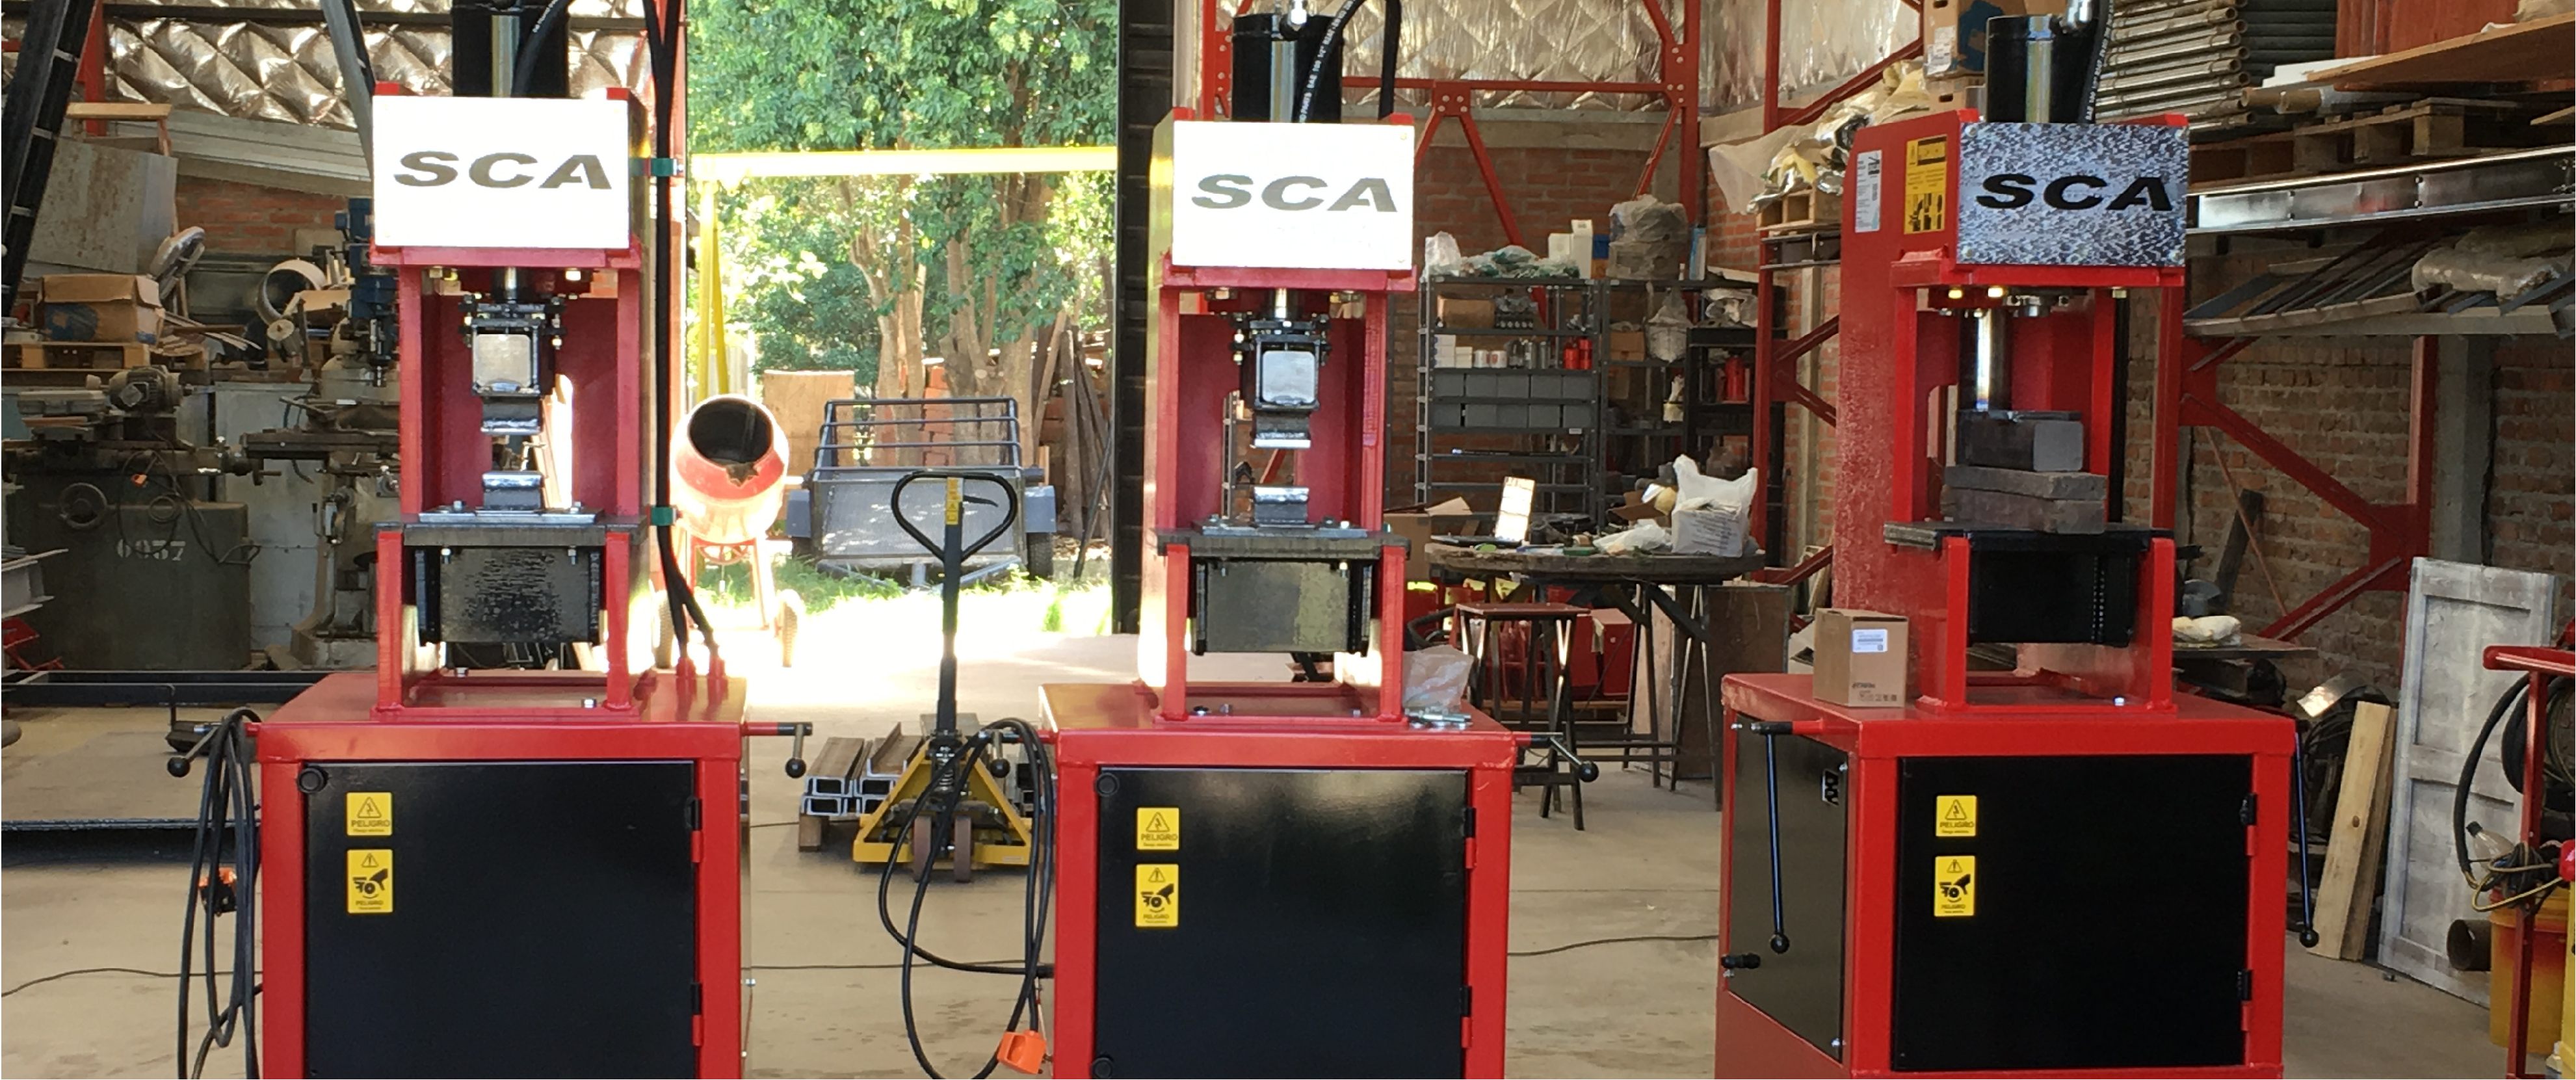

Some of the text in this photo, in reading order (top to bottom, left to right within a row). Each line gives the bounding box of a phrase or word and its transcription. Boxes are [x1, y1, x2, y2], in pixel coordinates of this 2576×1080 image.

[394, 151, 612, 190] SCA
[1191, 174, 1397, 213] SCA
[1976, 173, 2173, 211] SCA
